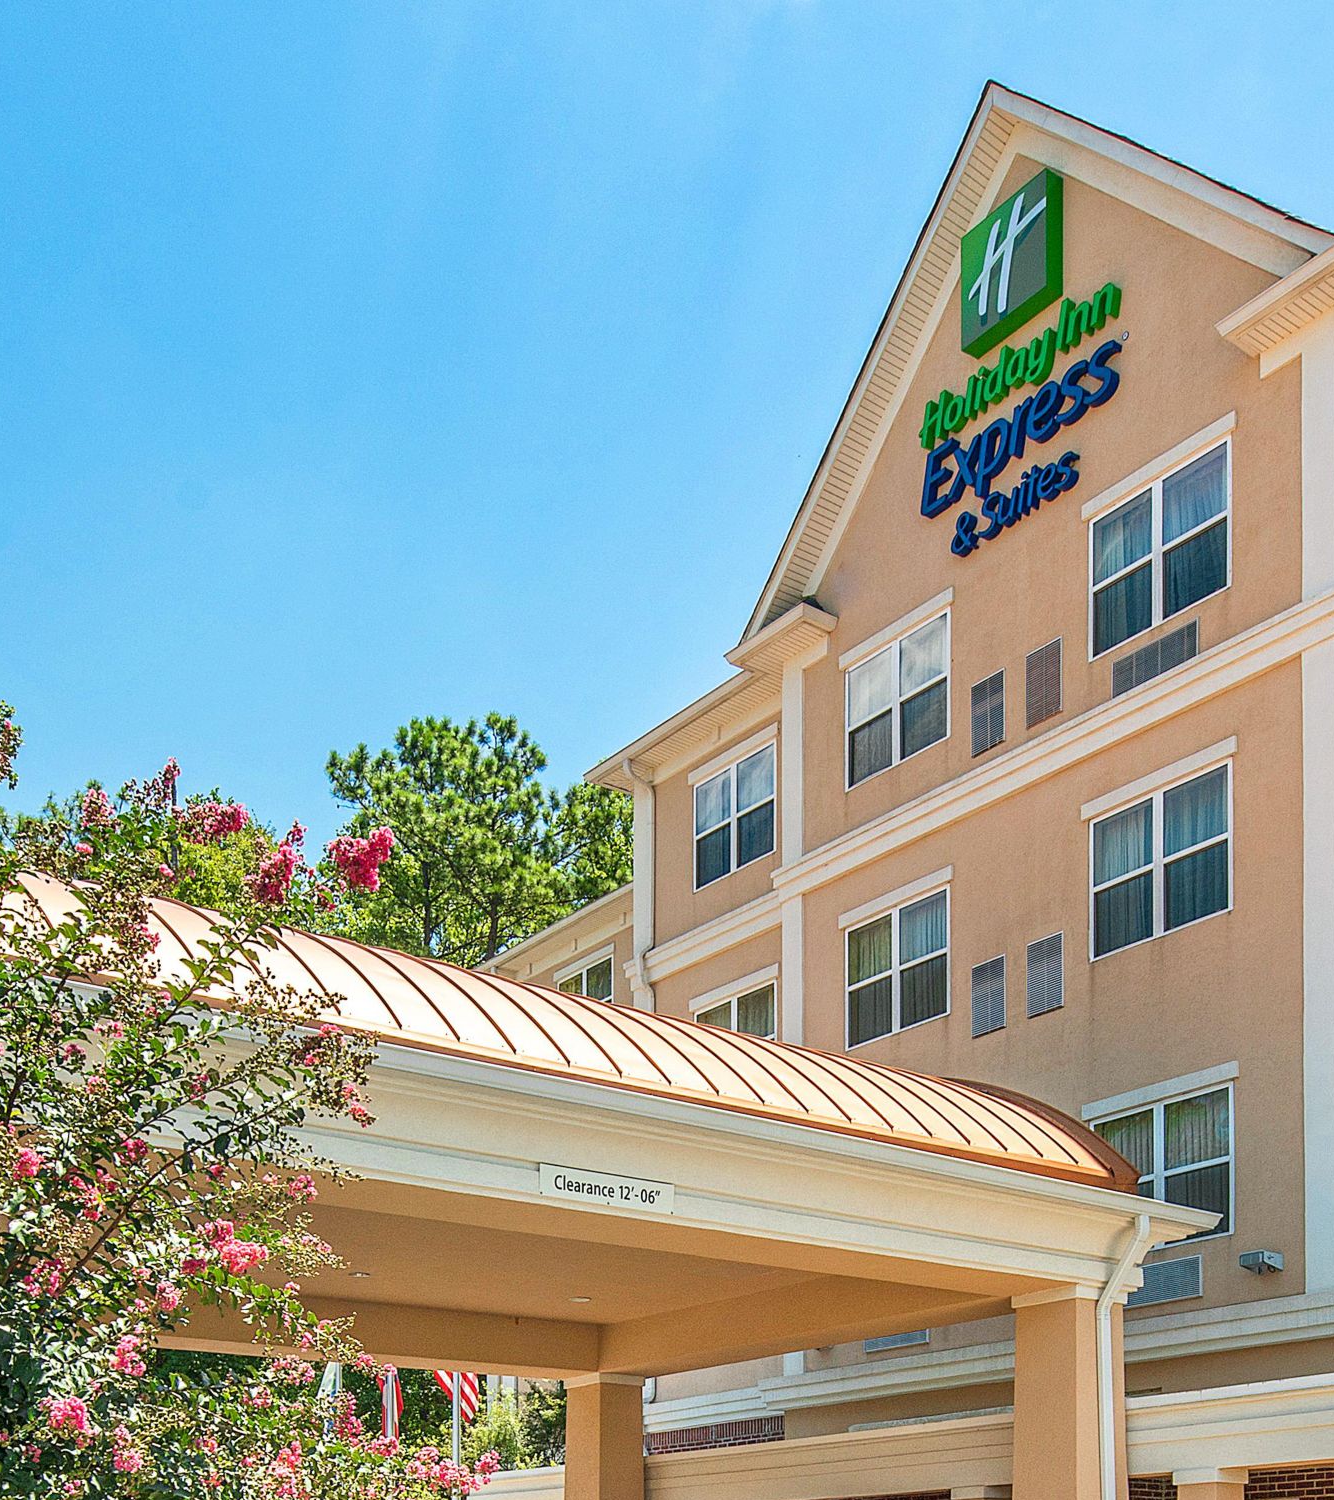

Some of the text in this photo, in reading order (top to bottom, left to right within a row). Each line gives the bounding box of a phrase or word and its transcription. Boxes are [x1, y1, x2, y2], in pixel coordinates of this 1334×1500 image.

[919, 282, 1121, 450] Holiday Inn
[920, 339, 1122, 519] Express
[950, 451, 1080, 558] & Suites
[554, 1174, 615, 1199] Clearance
